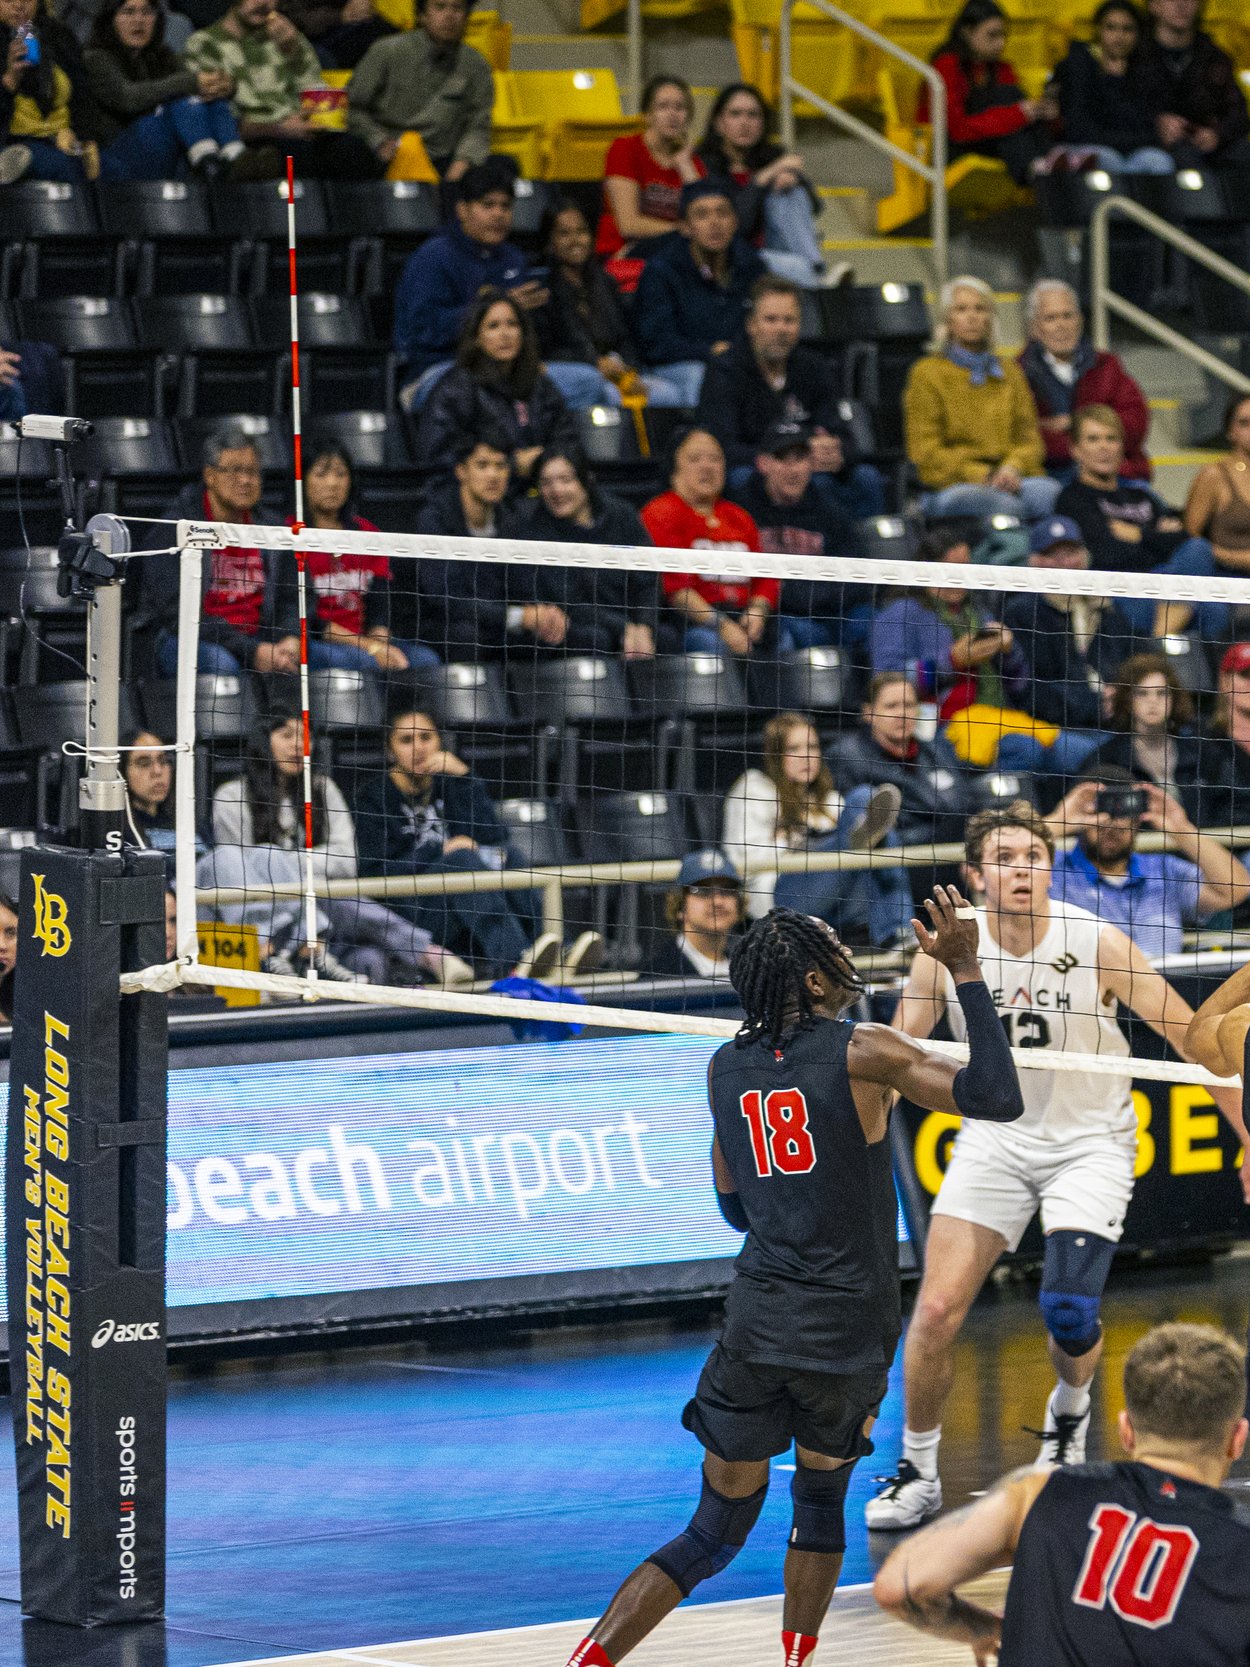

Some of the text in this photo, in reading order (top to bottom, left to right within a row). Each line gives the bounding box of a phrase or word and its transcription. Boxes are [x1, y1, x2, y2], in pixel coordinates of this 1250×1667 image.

[990, 985, 1072, 1011] EACH
[407, 1109, 663, 1221] airport
[739, 1087, 818, 1178] 18
[23, 1084, 44, 1446] MEN'S VOLLEYBALL
[45, 1010, 71, 1539] LONG BEACH STATE
[113, 1320, 159, 1343] asics
[116, 1415, 138, 1497] sports
[1071, 1502, 1201, 1630] 10
